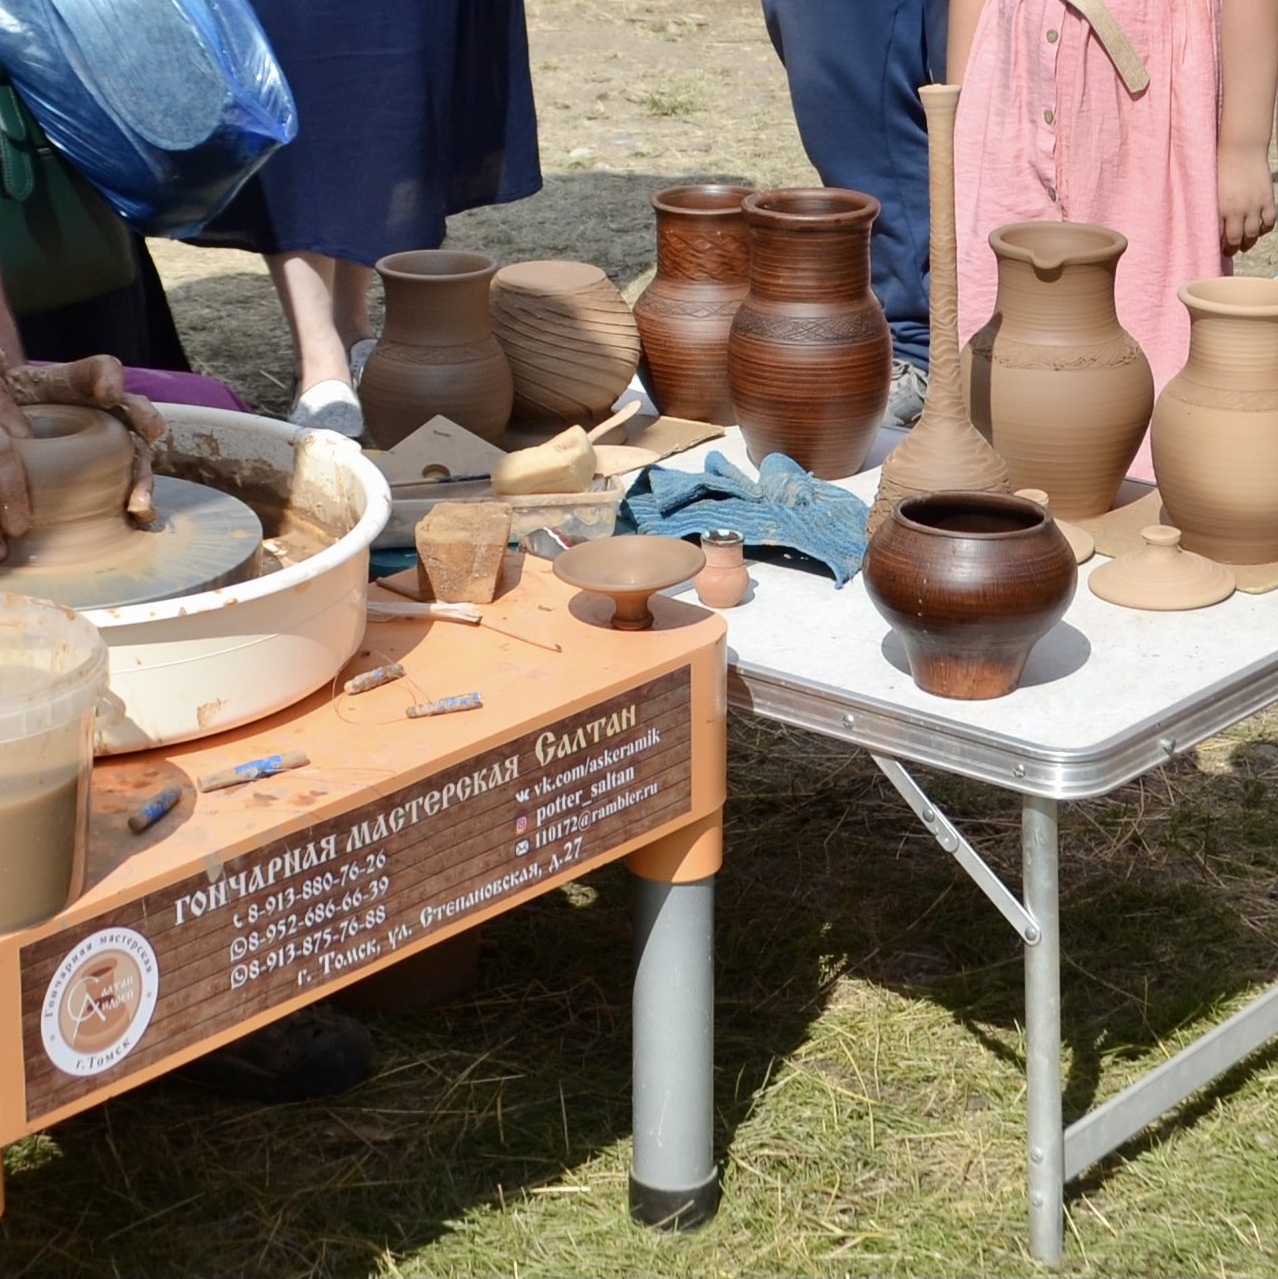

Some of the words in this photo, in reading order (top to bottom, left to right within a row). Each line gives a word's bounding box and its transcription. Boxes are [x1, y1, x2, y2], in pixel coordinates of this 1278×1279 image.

[534, 727, 661, 798] vk.com/askeramik
[536, 766, 635, 826] potter_saltan
[174, 834, 338, 926] ГОНЧАРНАЯ
[346, 754, 519, 853] МАСТЕРСКАЯ
[534, 781, 658, 849] 110172@rambler.ru
[247, 849, 386, 924] 8-913-880-76-26
[247, 876, 390, 951] 8-952-686-66-39
[297, 969, 313, 986] г.
[319, 938, 381, 975] Томск,
[388, 925, 412, 948] ул.
[420, 862, 542, 927] Степановская,
[44, 941, 93, 1018] Гончарная
[99, 933, 153, 973] мастерская
[248, 905, 386, 980] 8-913-875-76-88
